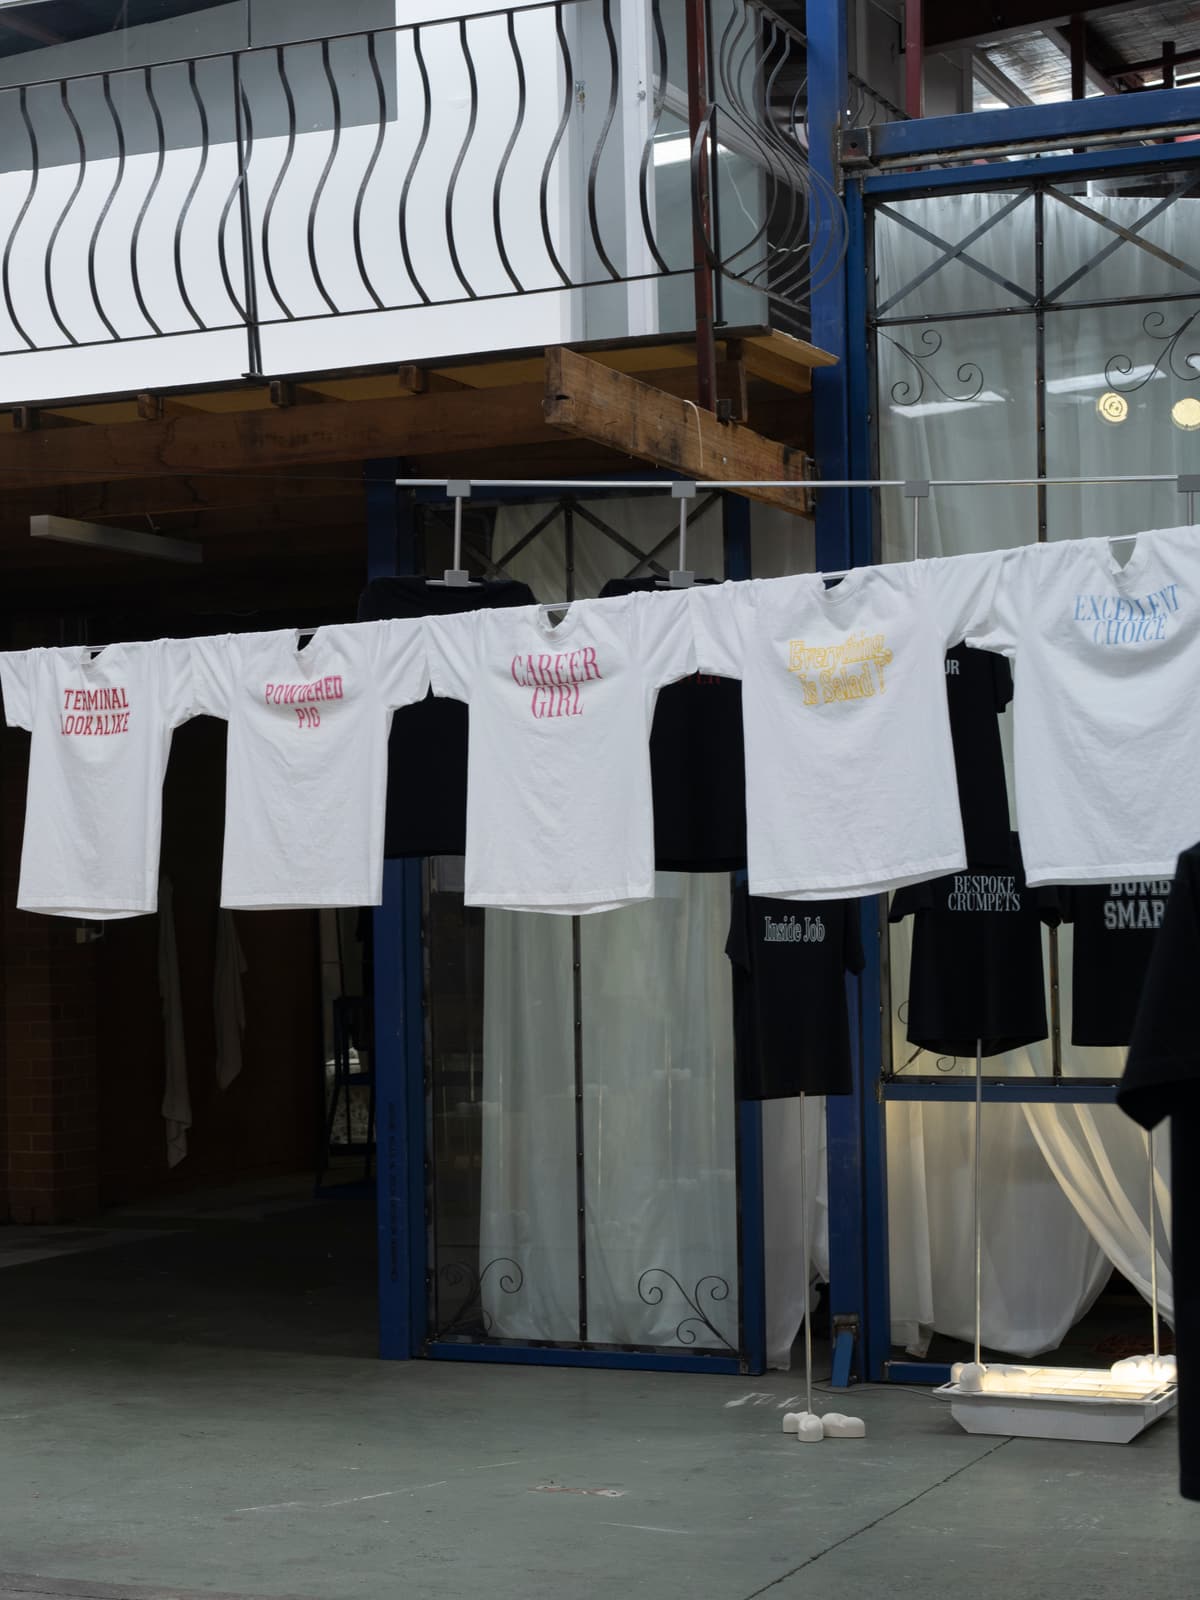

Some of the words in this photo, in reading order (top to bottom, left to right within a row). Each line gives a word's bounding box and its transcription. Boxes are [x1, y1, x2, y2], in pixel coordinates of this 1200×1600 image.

[1074, 584, 1179, 621] EXCELLENT
[1093, 618, 1166, 645] CHOICE
[511, 646, 603, 687] CAREER
[64, 688, 129, 711] TERMINAL
[265, 675, 344, 705] POWDERED
[531, 684, 584, 719] GIRL
[953, 875, 1016, 894] BESPOKE
[947, 892, 1021, 912] CRUMPETS
[1104, 899, 1168, 929] SMAR
[763, 915, 802, 943] Inside
[803, 915, 826, 943] Job
